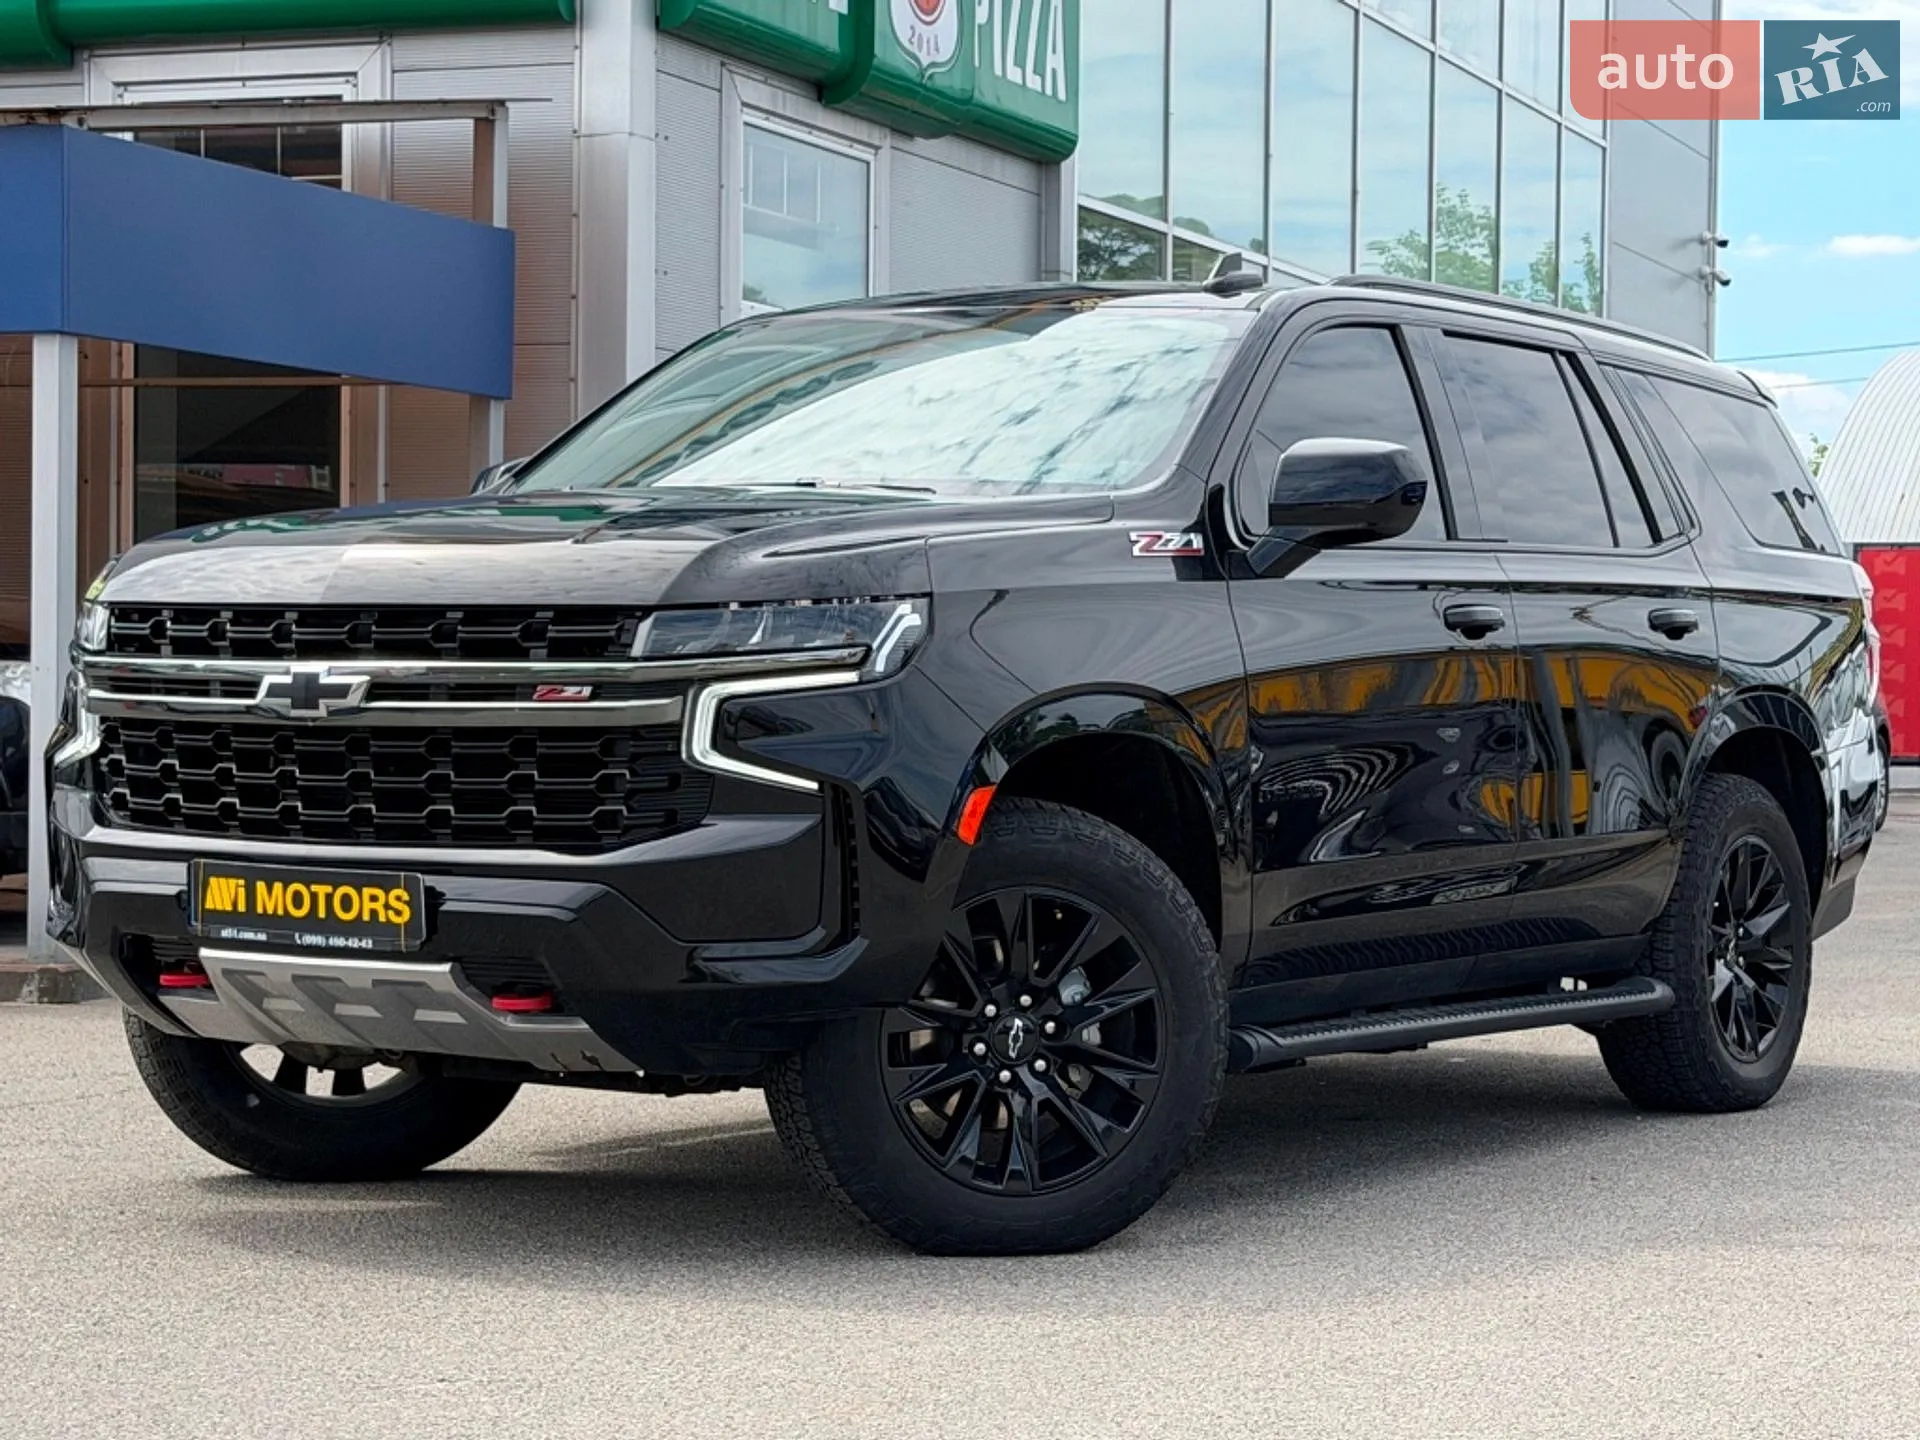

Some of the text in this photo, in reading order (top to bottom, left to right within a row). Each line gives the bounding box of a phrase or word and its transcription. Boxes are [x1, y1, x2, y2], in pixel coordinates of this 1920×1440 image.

[908, 25, 941, 57] 2014
[974, 0, 1067, 102] PIZZA
[1129, 530, 1204, 557] Z71
[255, 880, 411, 924] MOTORS
